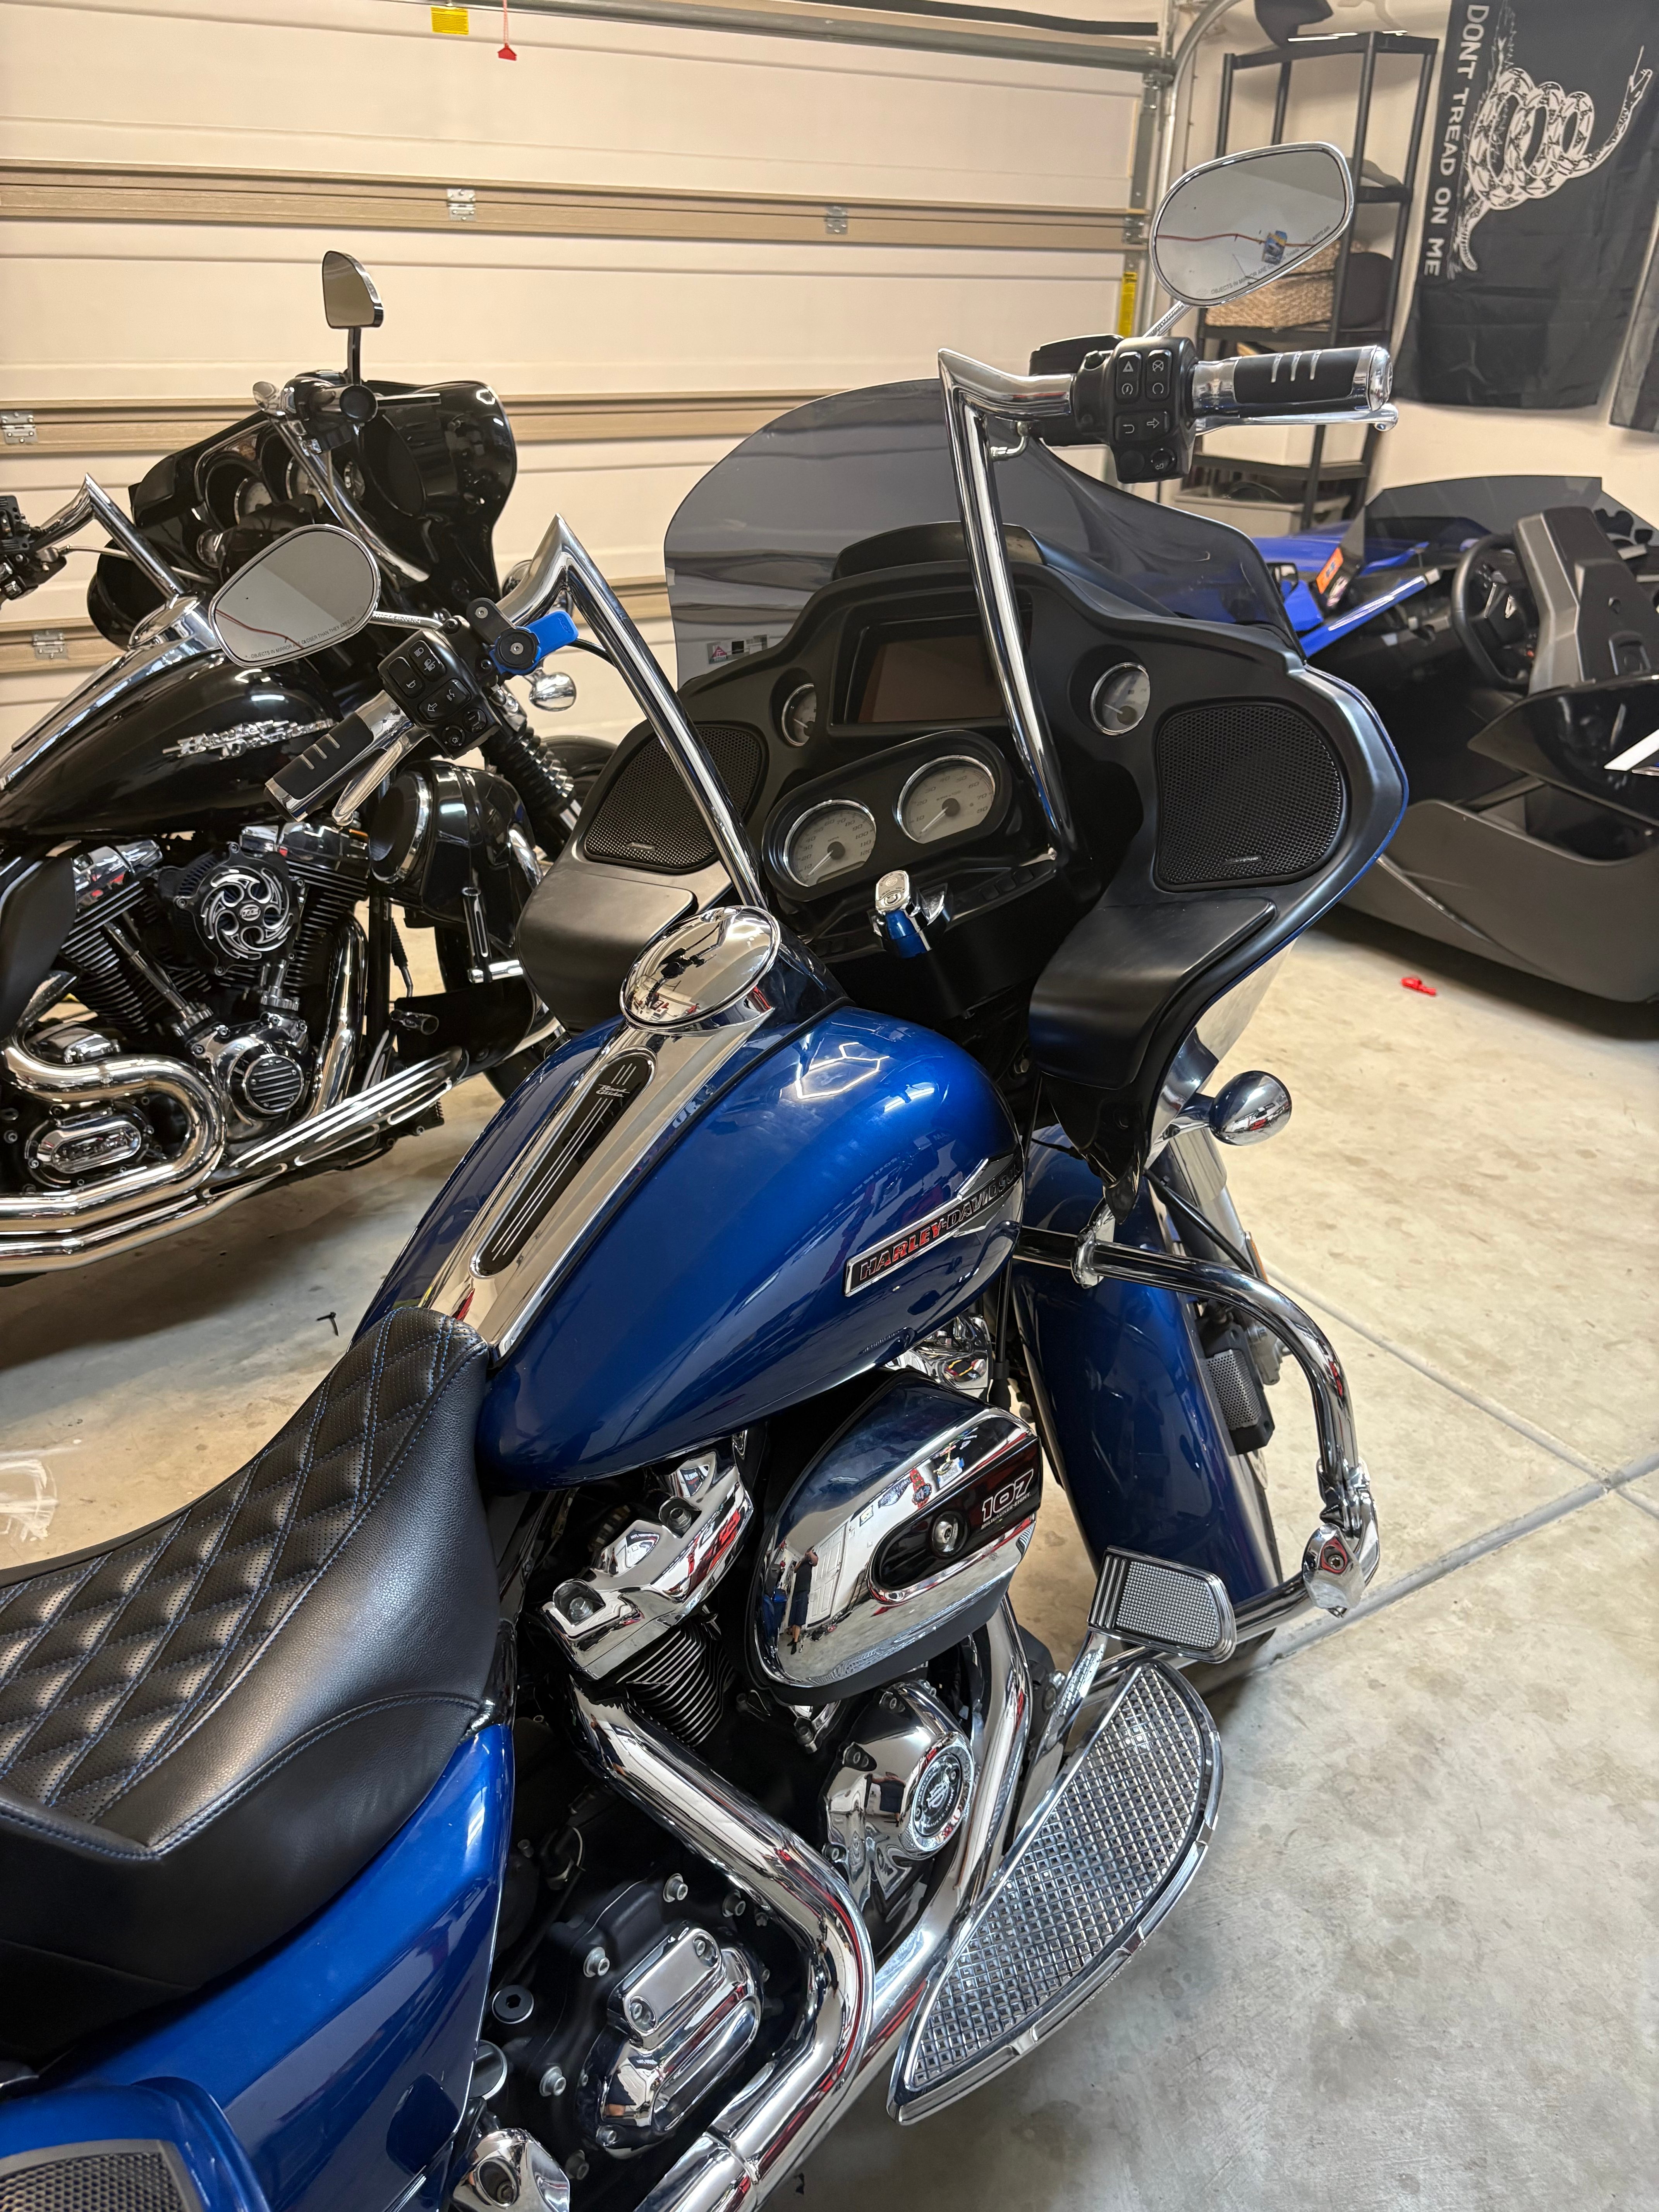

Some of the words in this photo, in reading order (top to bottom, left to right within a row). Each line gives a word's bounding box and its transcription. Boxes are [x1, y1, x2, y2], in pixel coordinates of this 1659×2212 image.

[1457, 5, 1489, 79] DONT
[1440, 87, 1470, 176] TREAD
[1430, 187, 1451, 224] ON
[1424, 238, 1445, 276] ME
[1211, 283, 1233, 294] OBJECTS
[251, 650, 270, 658] OBJECTS
[275, 644, 292, 653] MIRROR
[329, 625, 340, 634] THEY
[340, 616, 356, 629] APPEAR
[855, 831, 869, 840] 100
[596, 1089, 624, 1097] Glide
[598, 1084, 630, 1094] Road
[982, 1468, 1034, 1522] 107
